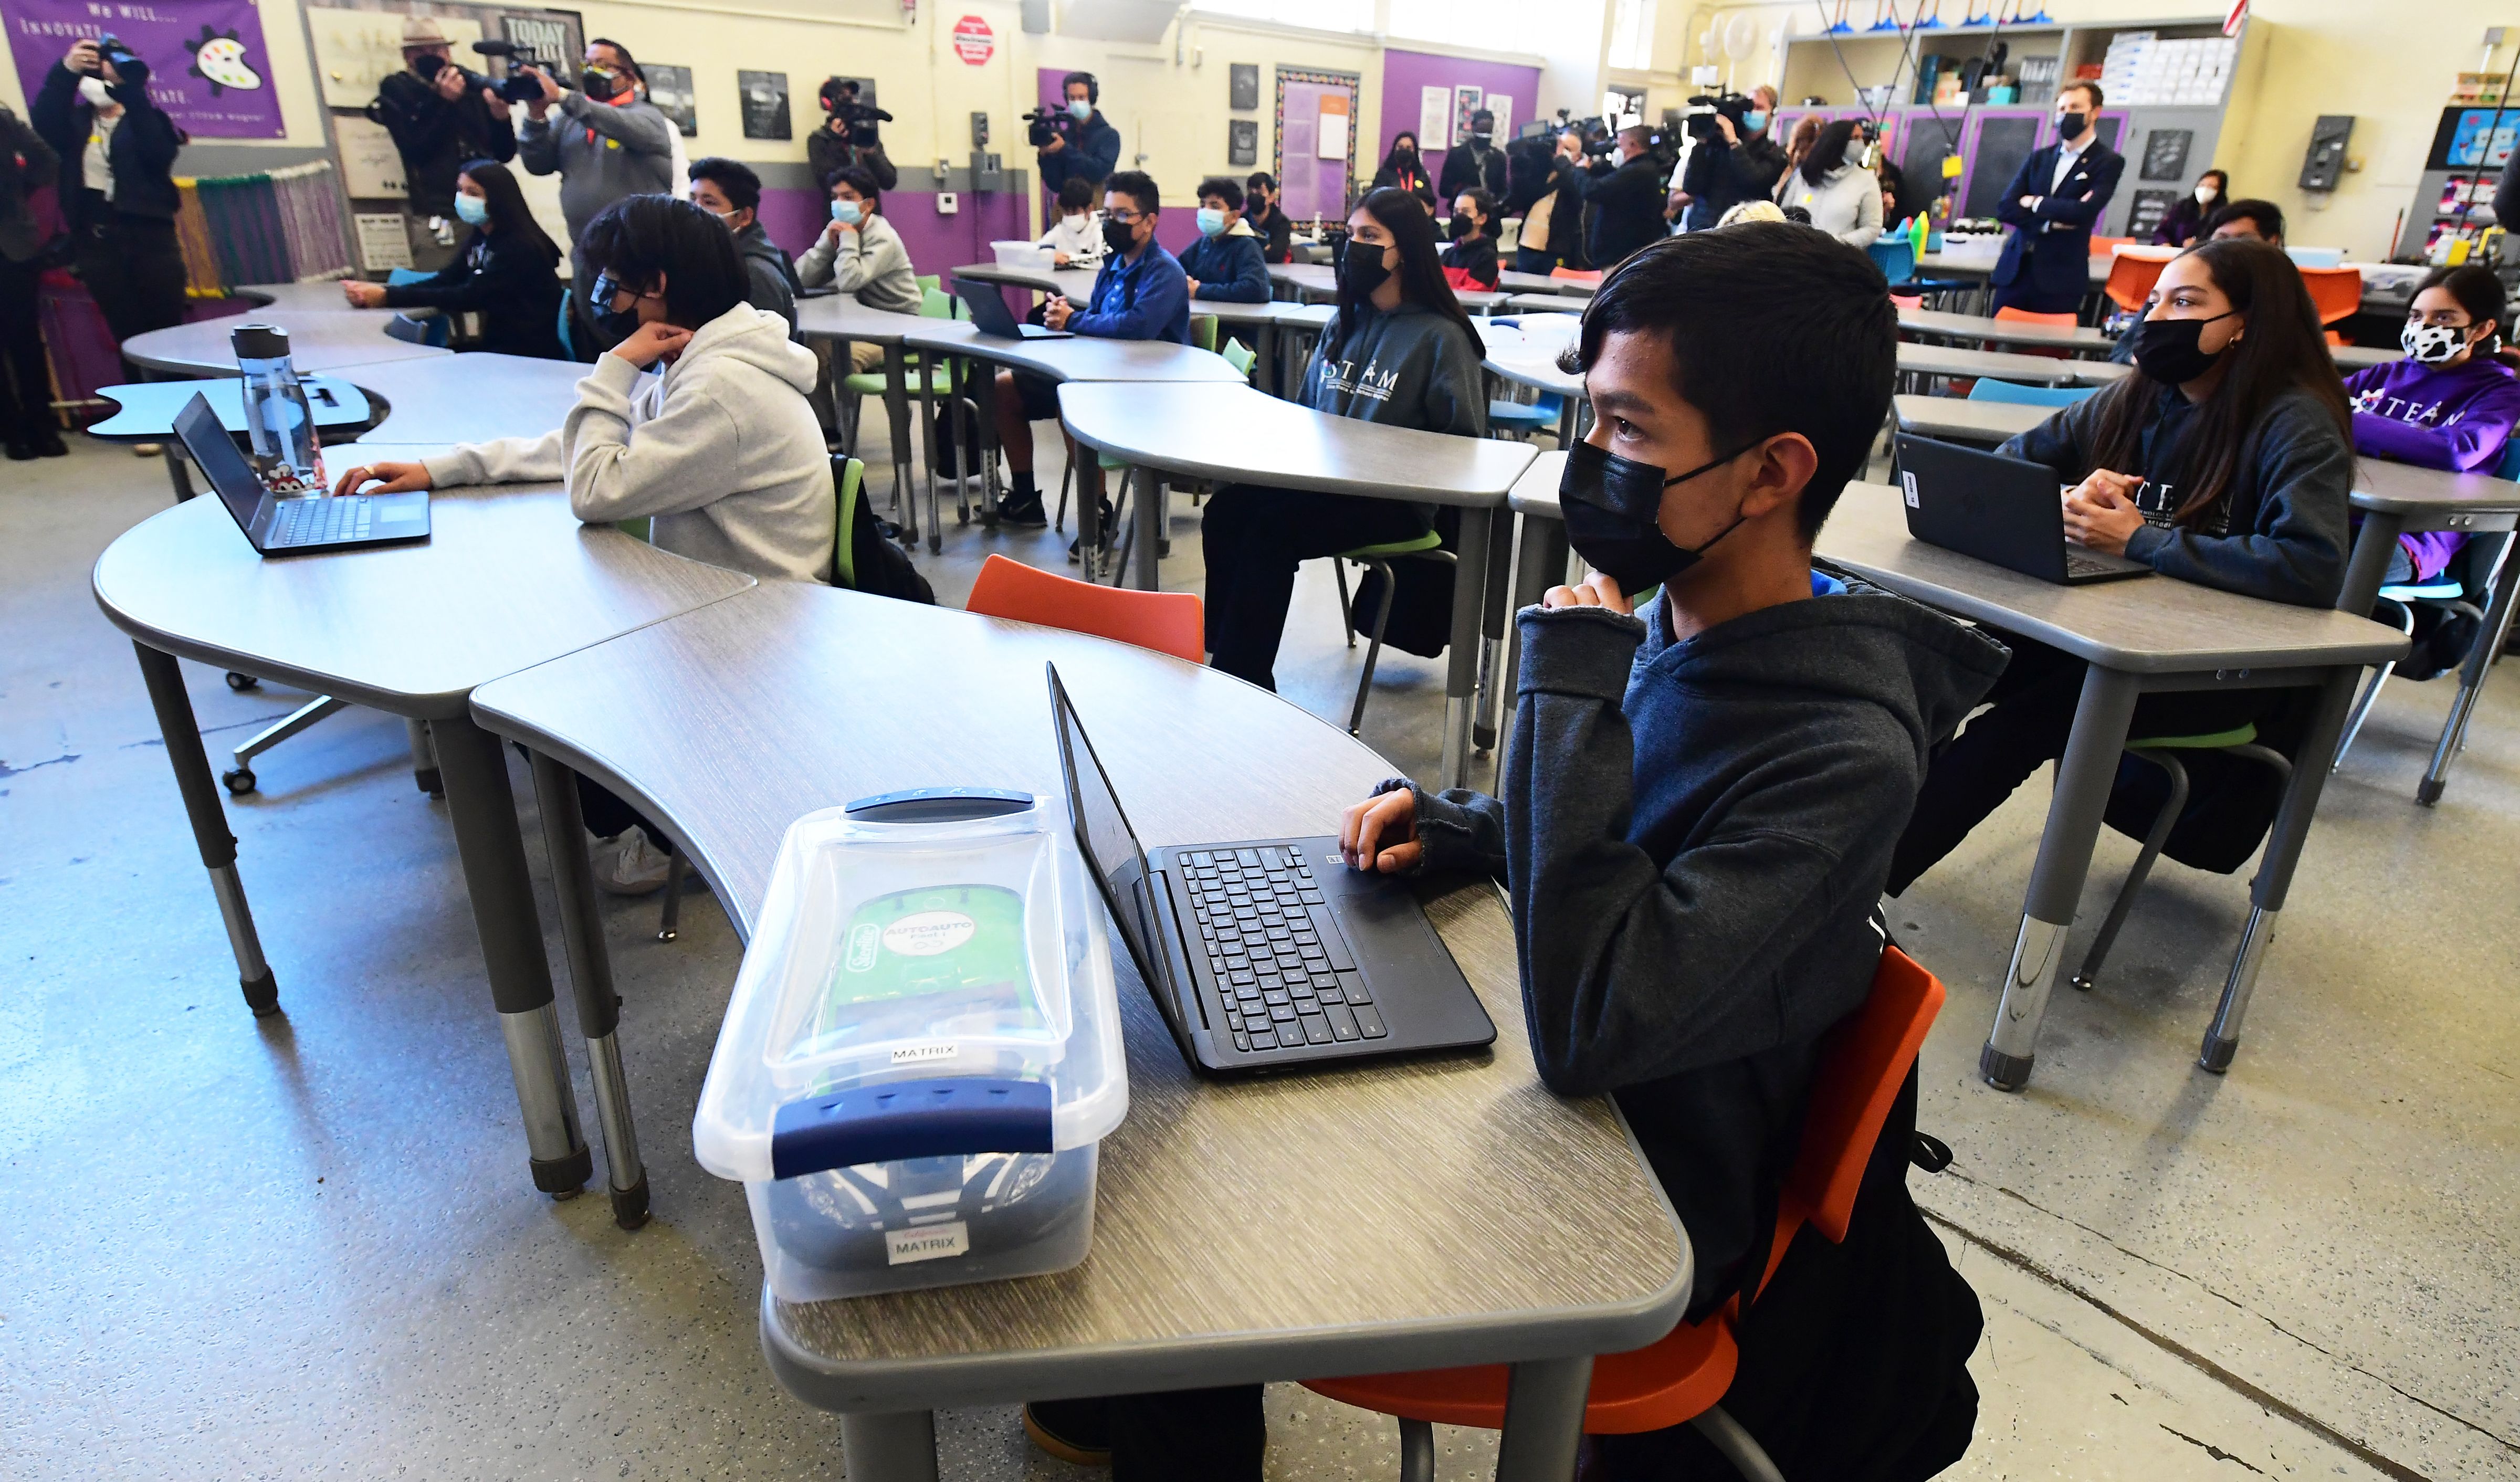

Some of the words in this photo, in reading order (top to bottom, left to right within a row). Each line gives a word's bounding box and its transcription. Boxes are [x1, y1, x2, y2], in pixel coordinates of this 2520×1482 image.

[87, 2, 112, 18] We
[506, 18, 566, 48] TODAY
[886, 922, 972, 936] AUTOAUTO
[894, 1046, 954, 1058] MATRIX
[896, 1237, 955, 1254] MATRIX
